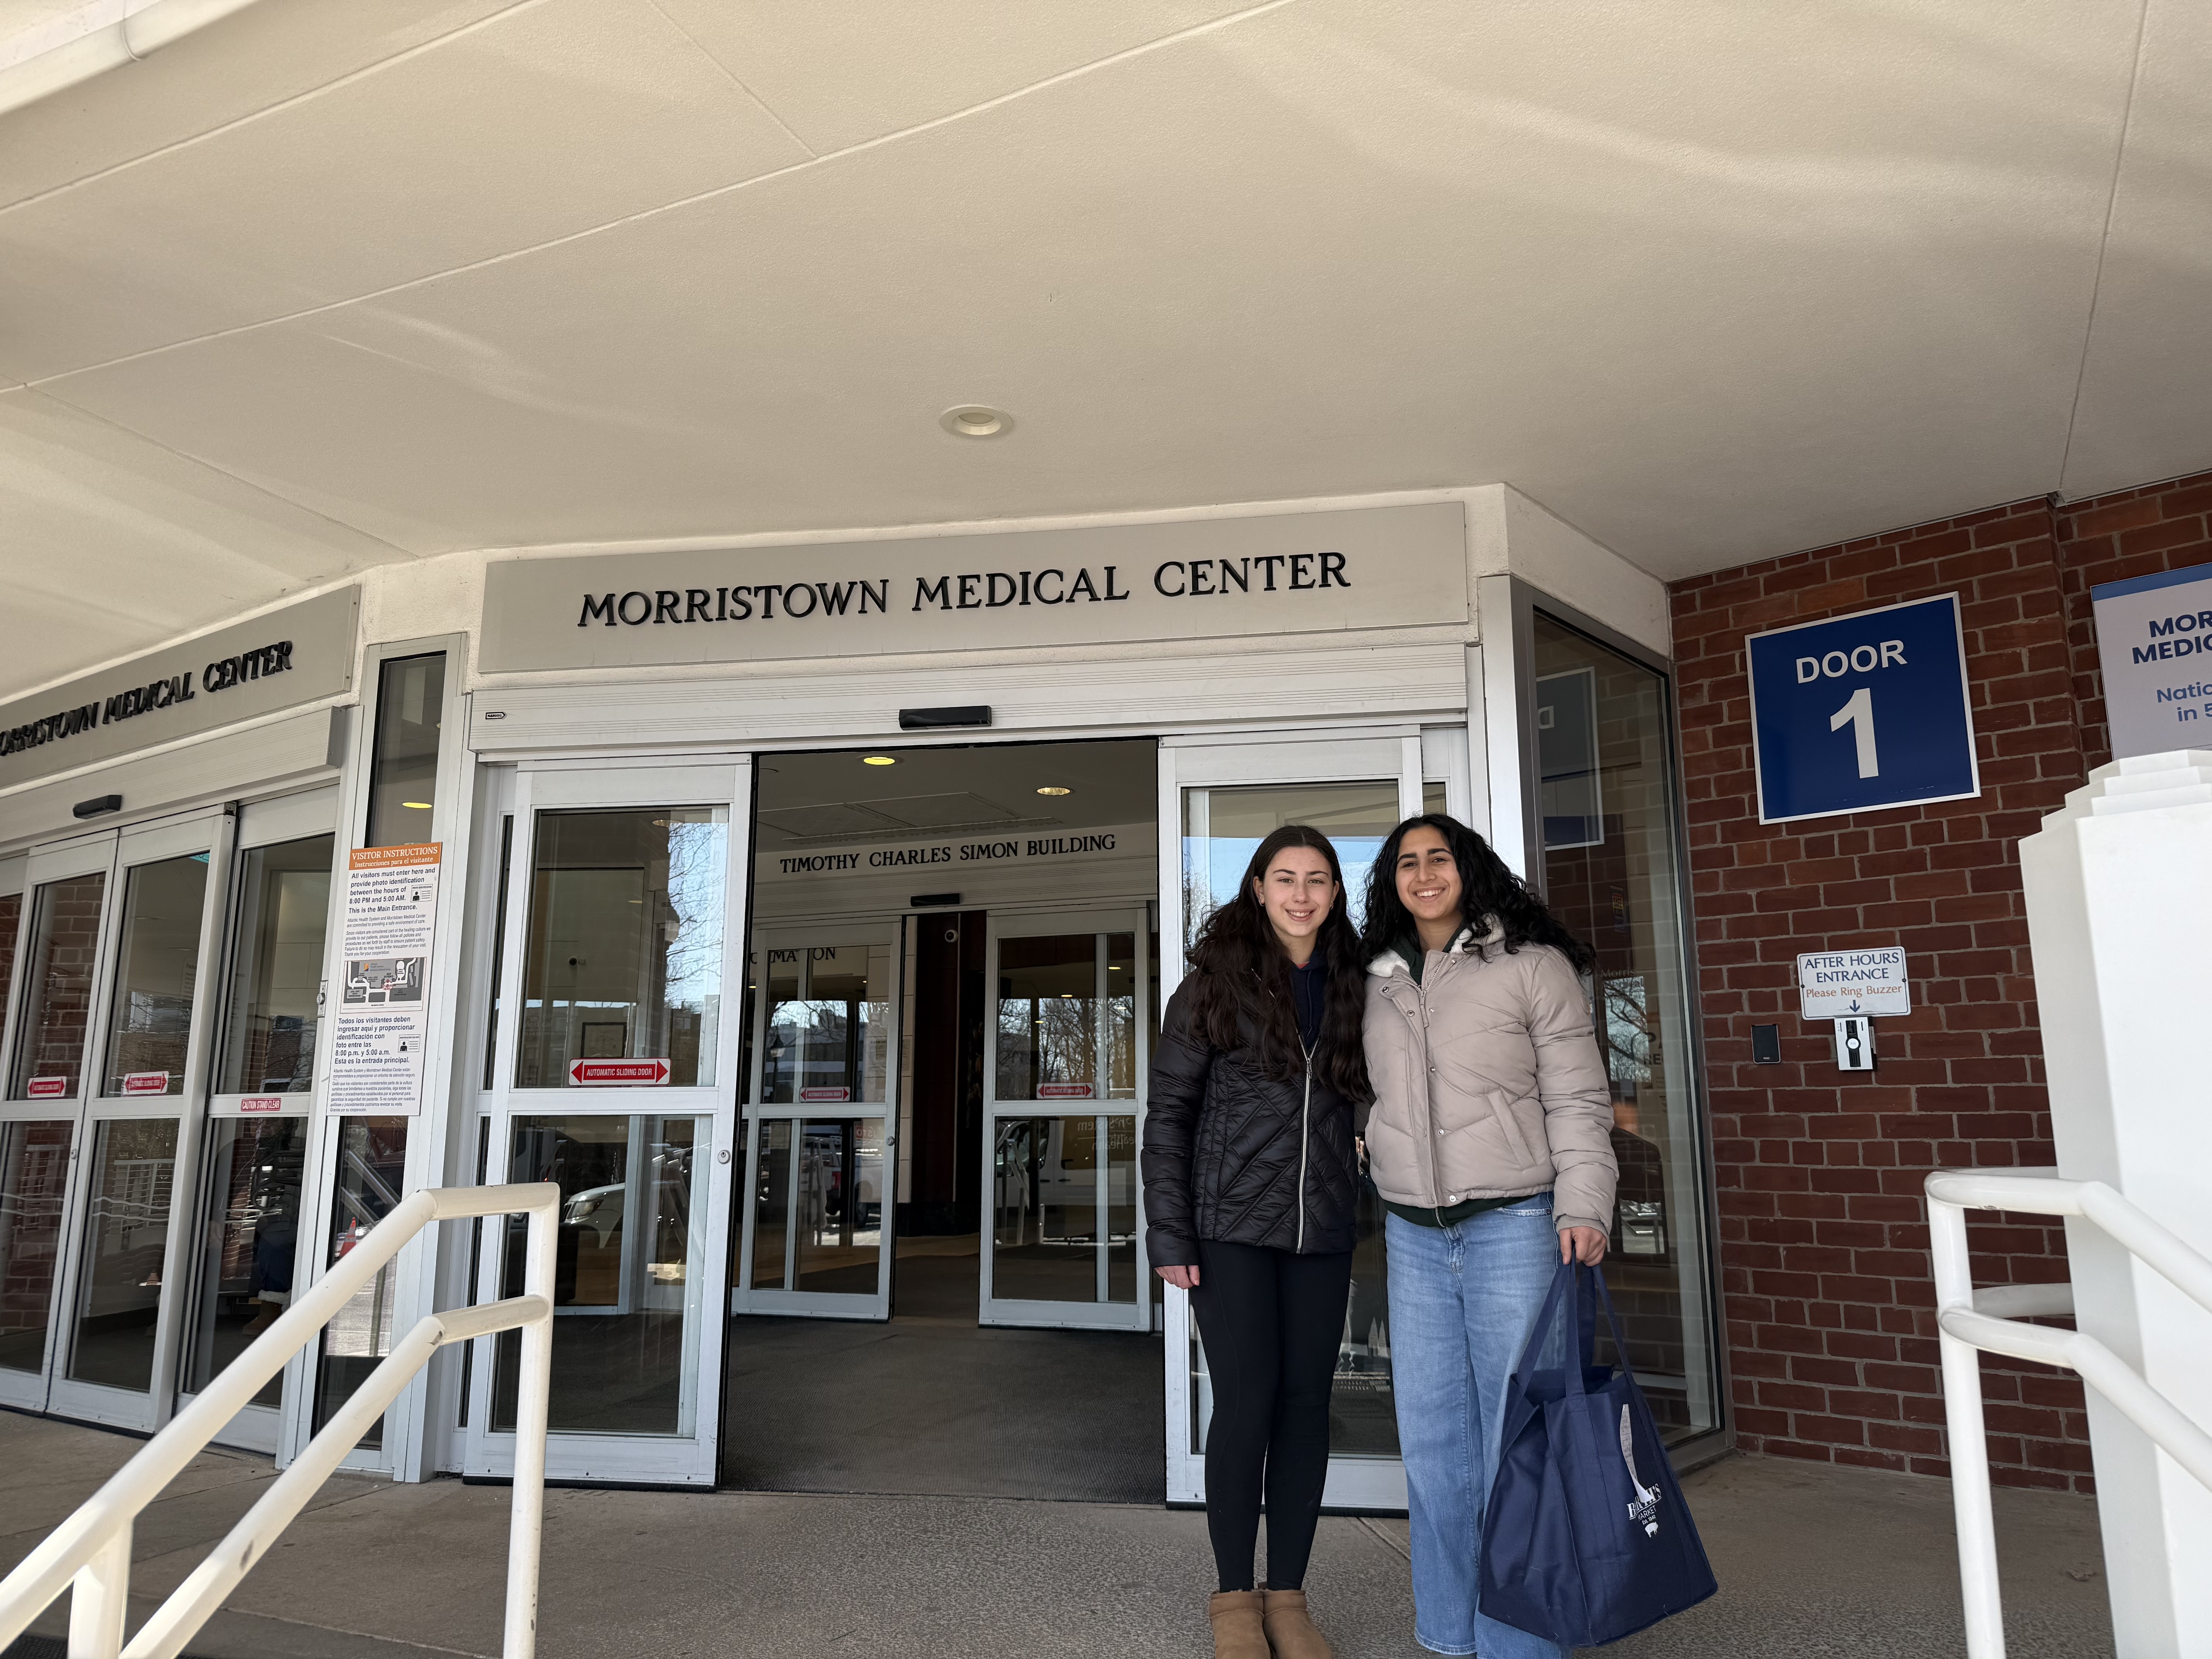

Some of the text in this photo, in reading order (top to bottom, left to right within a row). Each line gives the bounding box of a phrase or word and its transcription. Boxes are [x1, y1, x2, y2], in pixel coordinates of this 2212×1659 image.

[577, 552, 1351, 627] MORRISTOWN MEDICAL CENTER
[1795, 639, 1908, 684] DOOR
[102, 672, 195, 725] MEDICAL
[203, 640, 293, 693] CENTER
[2177, 707, 2197, 722] in
[1830, 687, 1879, 779] 1
[352, 846, 437, 860] VISITOR INSTRUCTIONS
[780, 834, 1116, 874] TIMOTHY CHARLES SIMON BUILDING
[1805, 952, 1899, 969] AFTER HOURS
[1816, 968, 1889, 983] ENTRANCE
[1806, 985, 1902, 998] Please Ring Buzzer
[242, 1100, 280, 1109] CAUTION STAND CLEAR
[1637, 1505, 1656, 1522] MARKET
